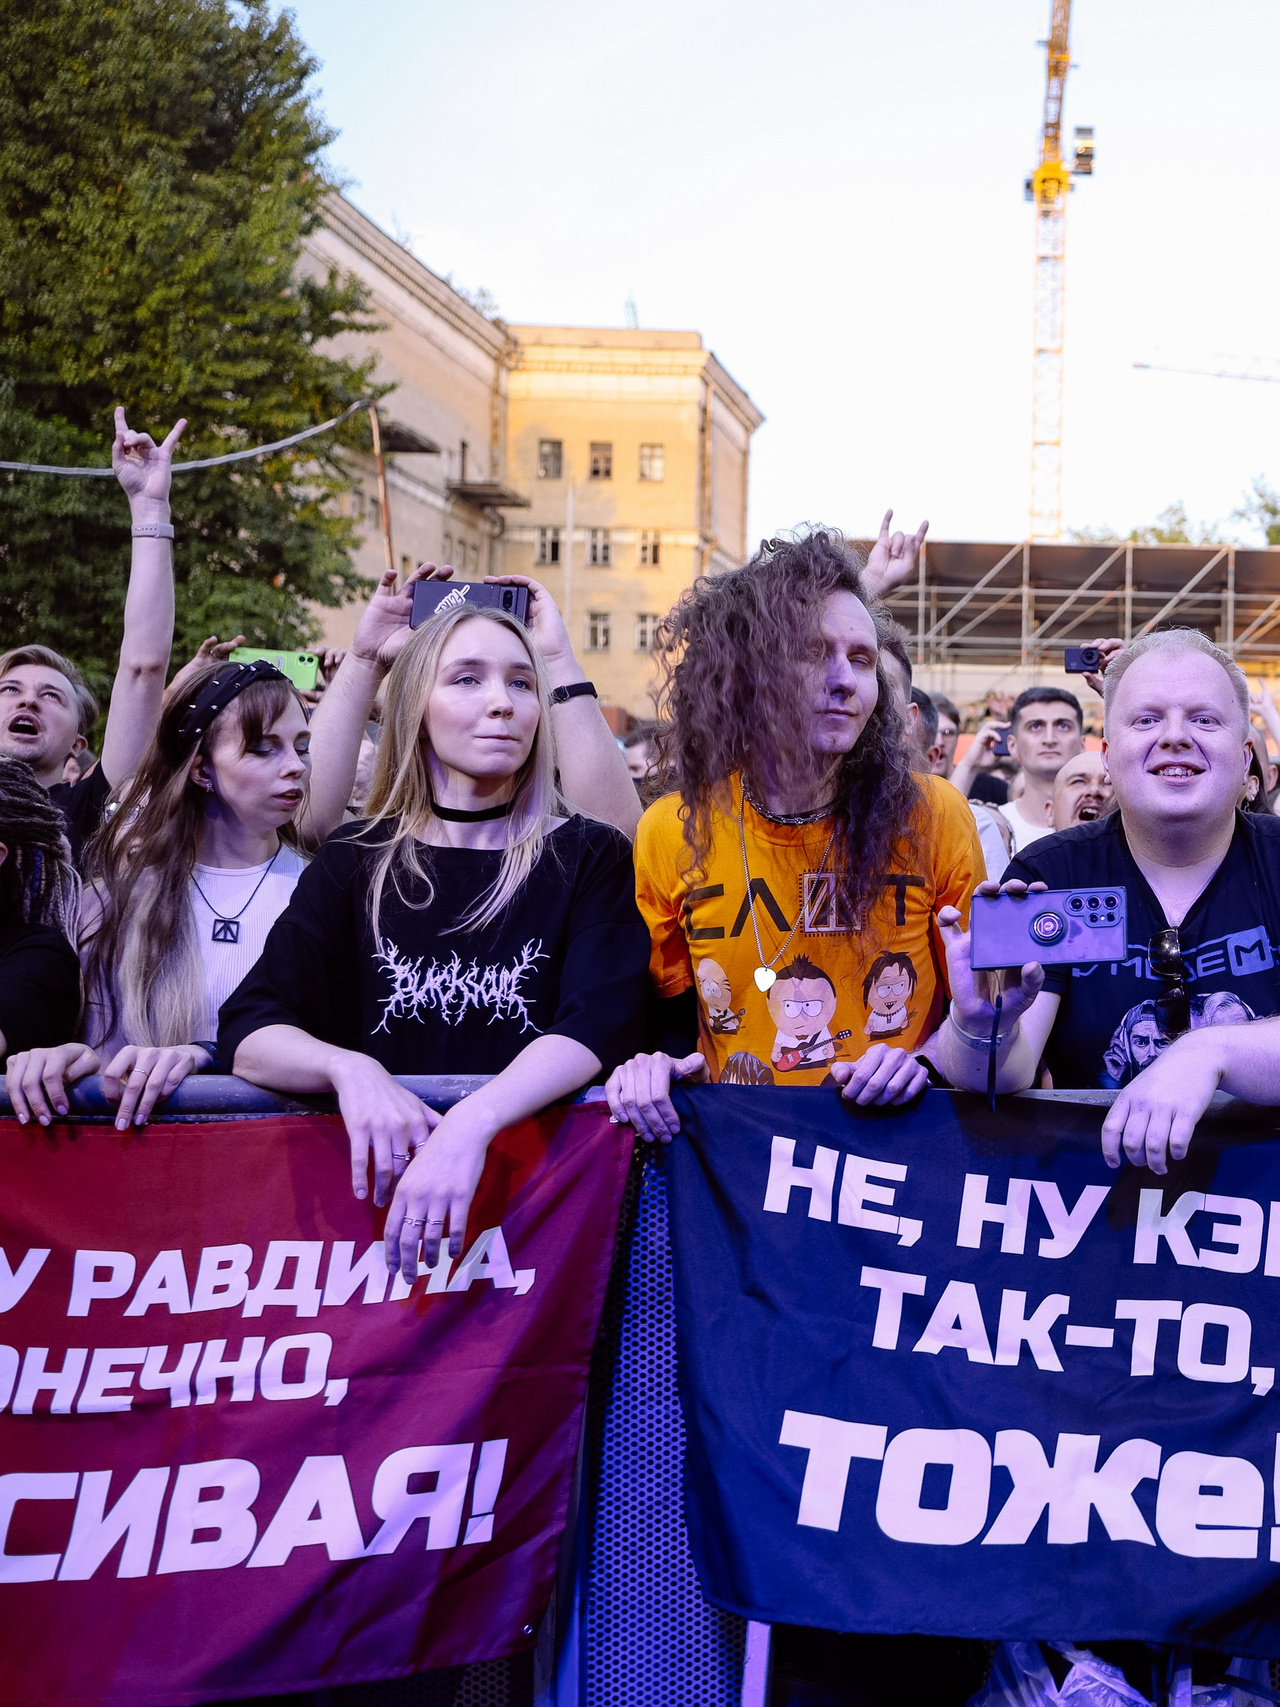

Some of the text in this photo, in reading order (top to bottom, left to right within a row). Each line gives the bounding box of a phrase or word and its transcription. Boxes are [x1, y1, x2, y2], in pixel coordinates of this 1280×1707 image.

[762, 1136, 923, 1247] НЕ,
[957, 1173, 1112, 1259] НУ
[67, 1225, 536, 1318] РАВДИНА,
[860, 1266, 1275, 1397] ТАК-ТО,
